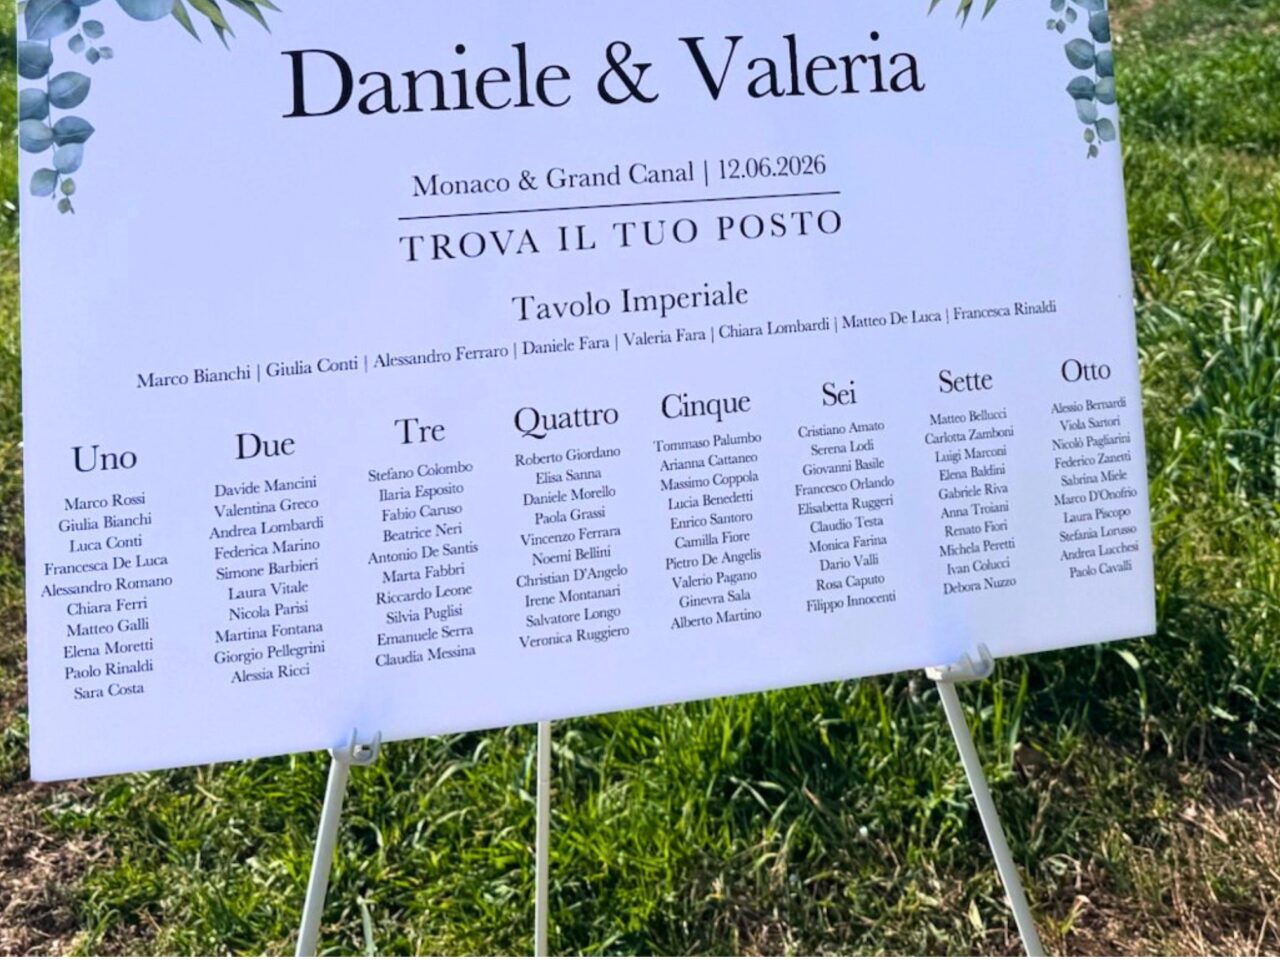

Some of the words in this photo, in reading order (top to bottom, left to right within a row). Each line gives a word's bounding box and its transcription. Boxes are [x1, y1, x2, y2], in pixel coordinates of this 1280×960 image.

[280, 41, 571, 118] Daniele
[596, 40, 659, 105] &
[677, 30, 926, 101] Valeria
[412, 174, 510, 197] Monaco
[518, 169, 538, 191] &
[545, 164, 621, 189] Grand
[628, 160, 694, 184] Canal
[719, 154, 826, 180] 12.06.2026
[398, 228, 539, 262] TROVA
[558, 224, 596, 251] IL
[612, 218, 698, 247] TUO
[717, 209, 841, 241] POSTO
[511, 290, 611, 321] Tavolo
[621, 280, 748, 318] Imperiale
[136, 372, 189, 389] Marco
[193, 364, 251, 384] Bianchi
[265, 359, 313, 377] Giulia
[316, 355, 358, 373] Conti
[373, 348, 452, 368] Alessandro
[455, 345, 509, 361] Ferraro
[522, 337, 575, 355] Daniele
[578, 335, 610, 351] Fara
[622, 329, 672, 346] Valeria
[676, 327, 706, 342] Fara
[718, 323, 763, 339] Chiara
[767, 316, 830, 335] Lombardi
[842, 314, 887, 329] Matteo
[889, 311, 908, 325] De
[911, 309, 942, 324] Luca
[952, 306, 1011, 320] Francesca
[1013, 299, 1057, 316] Rinaldi
[1060, 358, 1111, 382] Otto
[938, 369, 993, 394] Sette
[821, 379, 857, 406] Sei
[661, 392, 751, 423] Cinque
[929, 412, 967, 426] Matteo
[968, 407, 1007, 422] Bellucci
[393, 417, 445, 445] Tre
[513, 406, 619, 440] Quattro
[797, 423, 846, 438] Cristiano
[848, 421, 885, 434] Amato
[1059, 418, 1087, 431] Viola
[1087, 414, 1121, 429] Sartori
[652, 439, 711, 453] Tommaso
[712, 431, 762, 447] Palumbo
[924, 431, 967, 445] Carlotta
[967, 424, 1014, 441] Zamboni
[236, 432, 295, 460] Due
[810, 443, 847, 456] Serena
[849, 438, 875, 453] Lodi
[71, 444, 137, 473] Uno
[1054, 454, 1096, 470] Federico
[1096, 449, 1132, 465] Zanetti
[214, 481, 260, 498] Davide
[264, 474, 317, 493] Mancini
[535, 471, 563, 485] Elisa
[565, 468, 602, 481] Sanna
[660, 476, 710, 492] Massimo
[711, 469, 759, 488] Coppola
[64, 496, 109, 511] Marco
[111, 491, 145, 507] Rossi
[378, 486, 412, 502] Ilaria
[414, 481, 465, 500] Esposito
[937, 484, 982, 500] Gabriele
[983, 482, 1009, 495] Riva
[213, 501, 277, 518] Valentina
[279, 498, 319, 511] Greco
[381, 506, 417, 522] Fabio
[418, 504, 463, 518] Caruso
[534, 509, 567, 525] Paola
[569, 505, 606, 521] Grassi
[57, 517, 99, 532] Giulia
[103, 511, 152, 529] Bianchi
[209, 524, 257, 540] Andrea
[260, 515, 324, 535] Lombardi
[670, 515, 708, 530] Enrico
[709, 512, 753, 525] Santoro
[809, 517, 853, 534] Claudio
[853, 515, 884, 529] Testa
[944, 524, 982, 538] Renato
[983, 518, 1008, 533] Fiori
[69, 539, 102, 553] Luca
[105, 533, 143, 549] Conti
[519, 532, 576, 546] Vincenzo
[578, 527, 621, 541] Ferrara
[673, 532, 719, 549] Camilla
[721, 530, 750, 544] Fiore
[214, 543, 269, 560] Federica
[272, 538, 320, 554] Marino
[367, 547, 418, 565] Antonio
[421, 545, 439, 559] De
[442, 540, 479, 556] Santis
[531, 548, 572, 566] Noemi
[574, 544, 611, 561] Bellini
[1059, 547, 1096, 561] Andrea
[1097, 541, 1139, 557] Lucchesi
[43, 561, 109, 576] Francesca
[112, 556, 132, 570] De
[135, 554, 168, 568] Luca
[215, 566, 265, 580] Simone
[268, 557, 319, 575] Barbieri
[382, 569, 421, 584] Marta
[424, 561, 465, 579] Fabbri
[819, 556, 851, 572] Dario
[852, 553, 879, 567] Valli
[1068, 564, 1097, 579] Paolo
[1097, 559, 1133, 575] Cavalli
[40, 579, 112, 597] Alessandro
[115, 576, 173, 591] Romano
[227, 586, 267, 601] Laura
[270, 579, 309, 595] Vitale
[815, 578, 843, 591] Rosa
[844, 574, 885, 590] Caputo
[942, 581, 982, 595] Debora
[983, 576, 1017, 590] Nuzzo
[376, 586, 432, 605] Riccardo
[435, 584, 472, 598] Leone
[524, 594, 556, 608] Irene
[558, 583, 621, 603] Montanari
[678, 594, 725, 608] Ginevra
[727, 588, 751, 602] Sala
[66, 601, 112, 616] Chiara
[116, 596, 148, 612] Ferri
[229, 604, 270, 621] Nicola
[274, 600, 309, 616] Parisi
[385, 608, 420, 625] Silvia
[423, 603, 463, 622] Puglisi
[66, 622, 114, 637] Matteo
[116, 616, 149, 632] Galli
[525, 612, 581, 628] Salvatore
[583, 607, 621, 621] Longo
[670, 615, 713, 630] Alberto
[715, 607, 762, 624] Martino
[215, 627, 268, 644] Martina
[271, 623, 323, 637] Fontana
[518, 633, 573, 648] Veronica
[575, 624, 630, 643] Ruggiero
[63, 644, 100, 659] Elena
[104, 637, 154, 655] Moretti
[213, 647, 264, 665] Giorgio
[266, 639, 325, 659] Pellegrini
[64, 664, 102, 680] Paolo
[105, 658, 153, 676] Rinaldi
[231, 669, 274, 684] Alessia
[277, 662, 310, 678] Ricci
[73, 686, 104, 700] Sara
[107, 683, 144, 697] Costa
